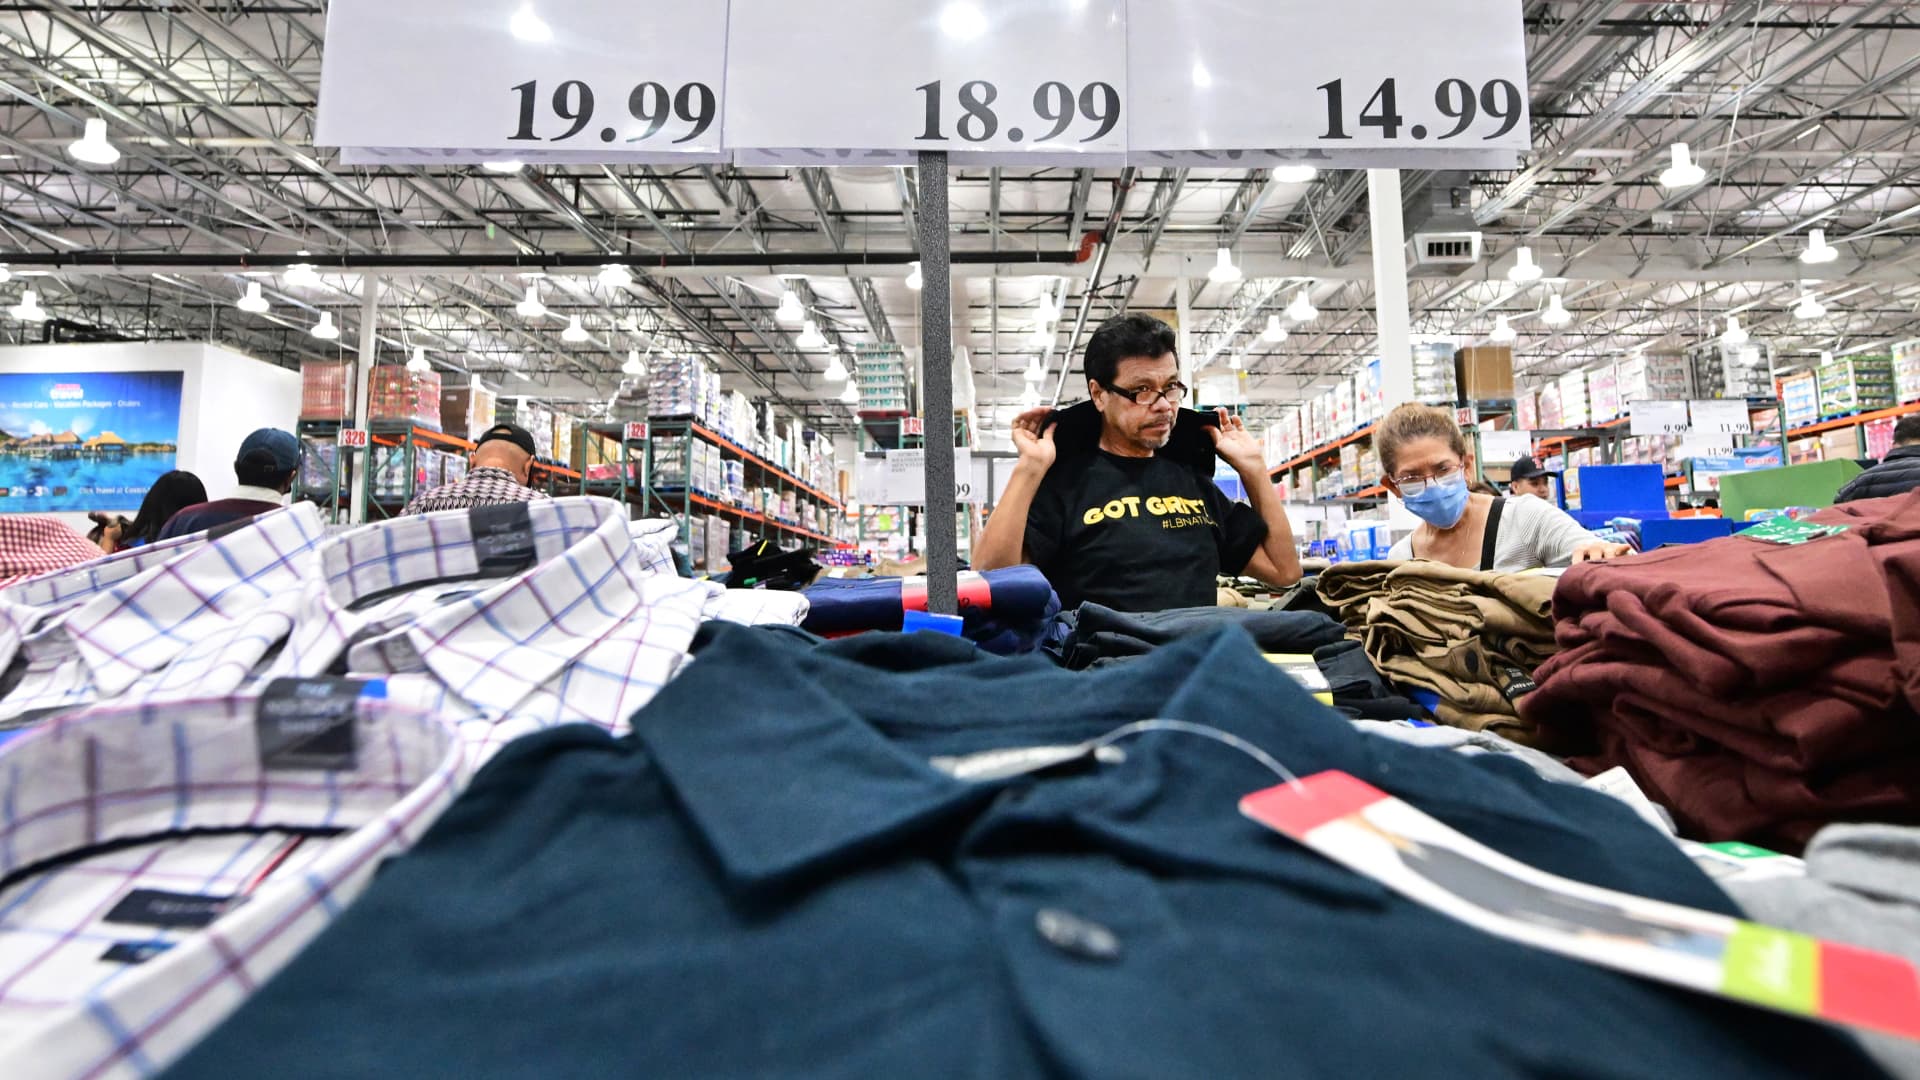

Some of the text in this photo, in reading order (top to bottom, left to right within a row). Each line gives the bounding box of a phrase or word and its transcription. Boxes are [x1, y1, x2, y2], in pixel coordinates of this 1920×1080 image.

[507, 79, 716, 144] 19.99
[914, 79, 1121, 143] 18.99
[1316, 78, 1522, 140] 14.99
[345, 430, 366, 446] 328
[1663, 423, 1688, 434] 9.99
[1719, 423, 1750, 434] 11.99
[1707, 447, 1733, 457] 11.99
[1083, 496, 1140, 525] GOT
